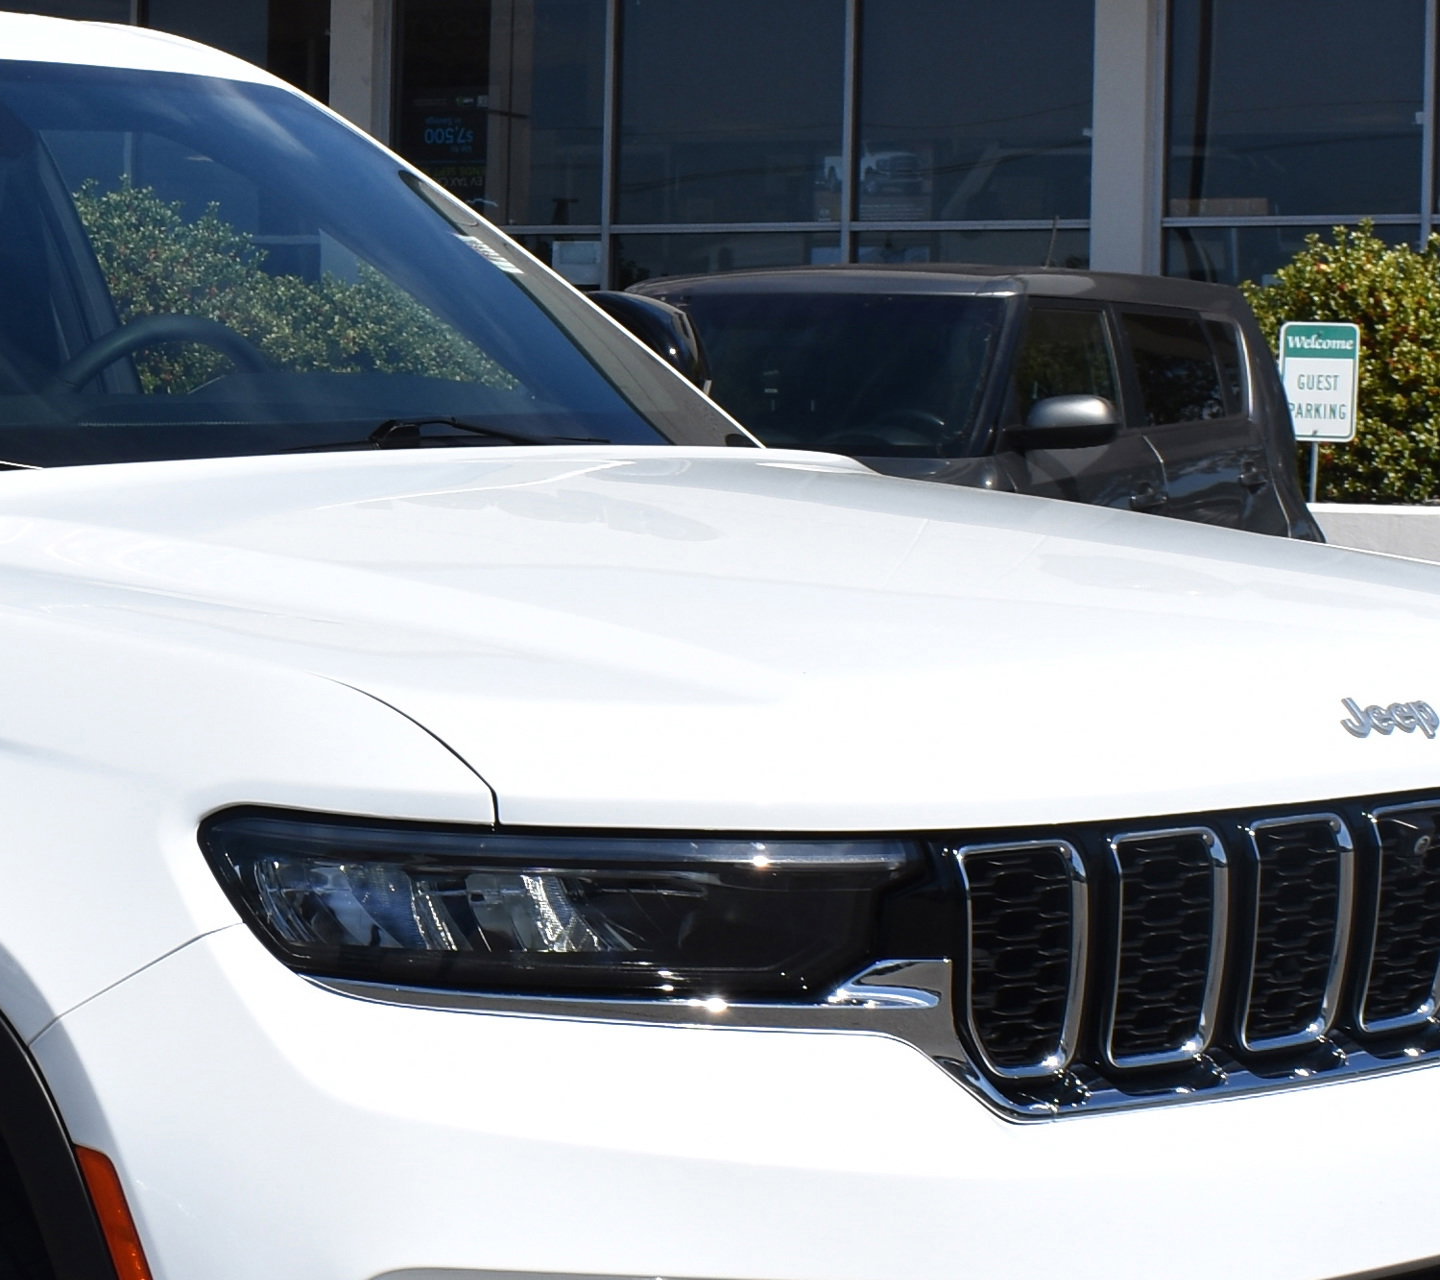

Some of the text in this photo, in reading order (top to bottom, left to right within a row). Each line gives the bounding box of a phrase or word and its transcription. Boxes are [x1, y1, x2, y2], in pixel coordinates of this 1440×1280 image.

[1287, 334, 1354, 350] Welcome
[1297, 374, 1339, 391] GUEST
[1340, 696, 1440, 739] Jeep
